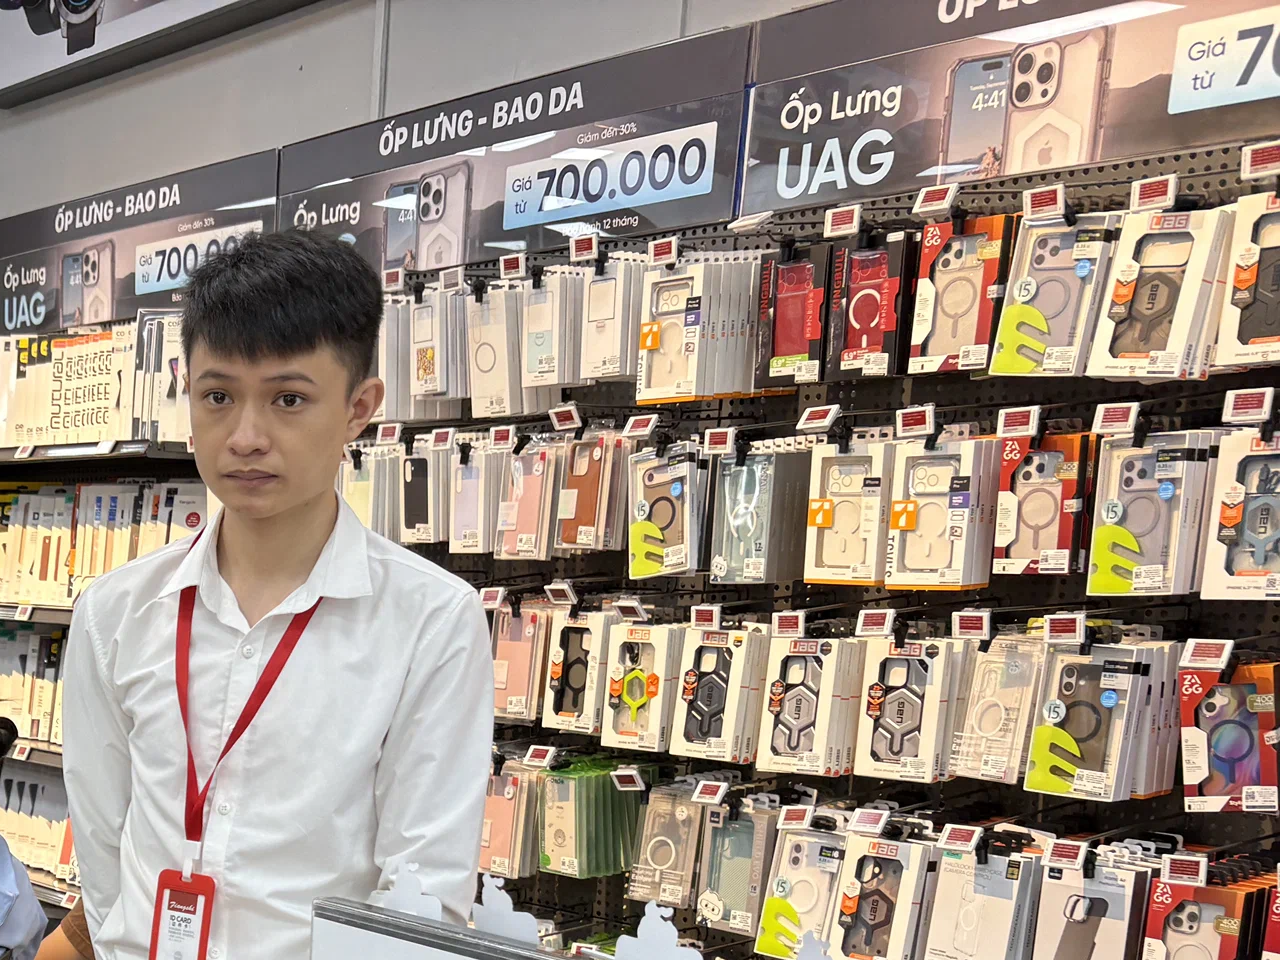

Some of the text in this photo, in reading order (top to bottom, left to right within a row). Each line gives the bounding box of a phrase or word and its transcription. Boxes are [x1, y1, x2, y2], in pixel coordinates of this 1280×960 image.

[1188, 38, 1226, 62] Giá
[1191, 70, 1215, 92] từ
[780, 83, 903, 134] Ốp Lưng
[971, 88, 1007, 112] 4:41
[378, 81, 584, 157] ỐP LƯNG BAO DA
[618, 121, 637, 137] 30%
[512, 137, 707, 213] Giá 700.000
[774, 128, 895, 200] UAG
[54, 183, 181, 234] ỐP LƯNG BAO DA
[320, 198, 361, 227] Lưng
[515, 198, 528, 215] từ
[602, 217, 612, 229] 12
[139, 254, 152, 268] Giá
[4, 265, 46, 292] Ốp Lưng
[4, 291, 45, 330] UAG
[789, 640, 817, 655] UAG
